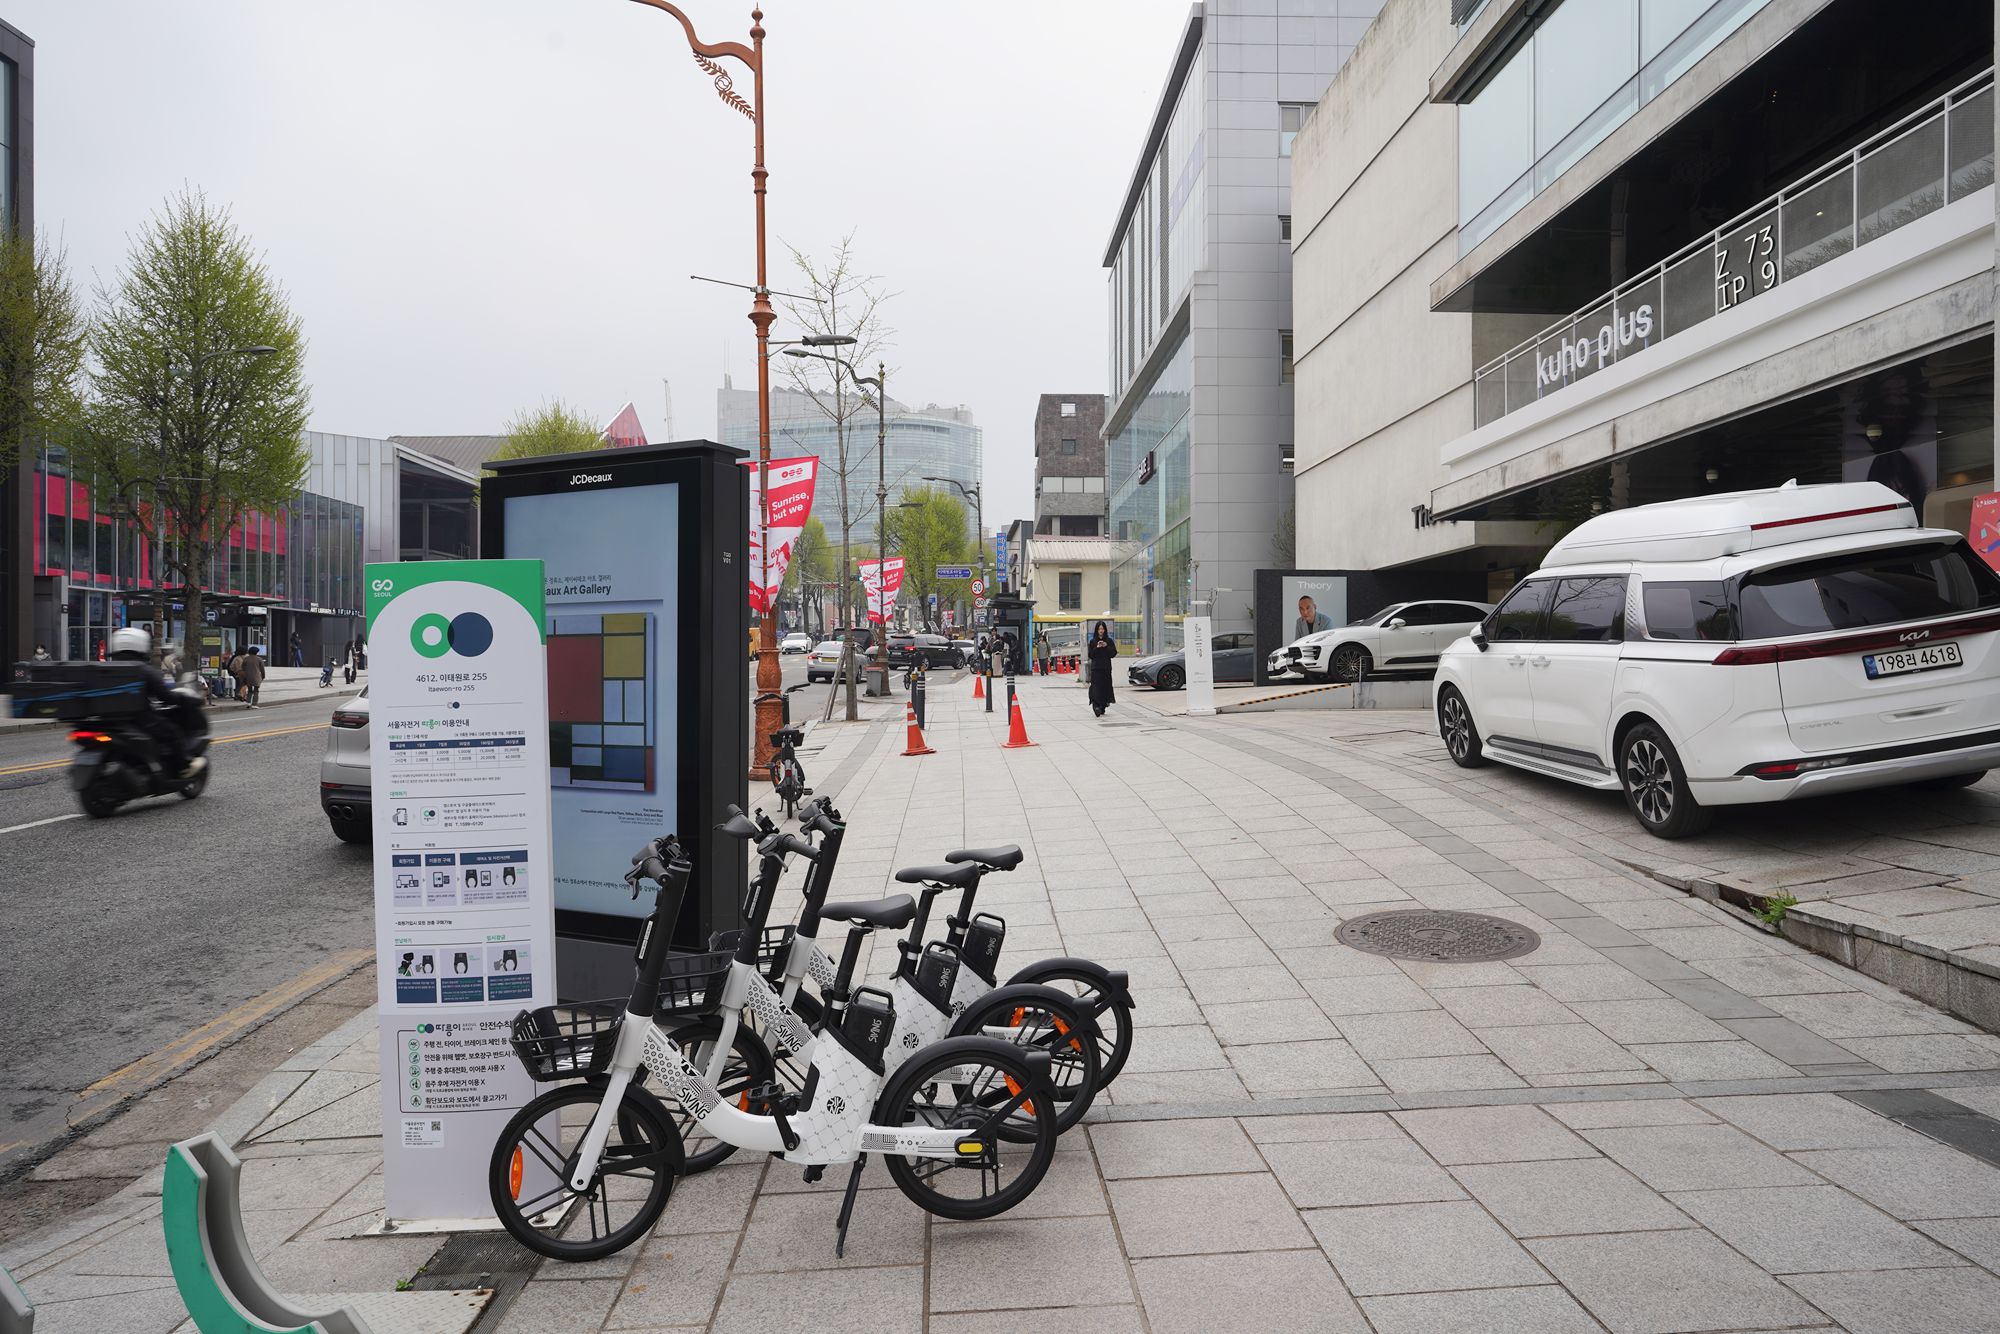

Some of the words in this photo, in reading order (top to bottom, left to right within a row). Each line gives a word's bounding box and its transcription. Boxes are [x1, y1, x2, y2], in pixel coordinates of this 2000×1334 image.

[1744, 226, 1774, 264] 73
[1718, 274, 1746, 312] IP
[1761, 260, 1776, 289] 9
[1536, 336, 1590, 389] kuho
[1598, 304, 1654, 362] plus
[570, 472, 612, 486] JCDecaux
[772, 492, 810, 511] Sunrise,
[773, 510, 787, 522] but
[788, 504, 804, 514] we
[564, 586, 577, 595] Art
[579, 584, 611, 595] Gallery
[974, 584, 981, 592] 50
[1298, 580, 1332, 592] Theory
[1920, 646, 1956, 664] 4618
[416, 674, 438, 682] 4612.
[440, 673, 470, 682] 이태원로
[472, 673, 487, 681] 255
[388, 720, 420, 728] 서울자전거
[421, 720, 440, 730] 따릉이
[442, 719, 470, 728] 이용안내
[436, 1024, 460, 1036] 따릉이
